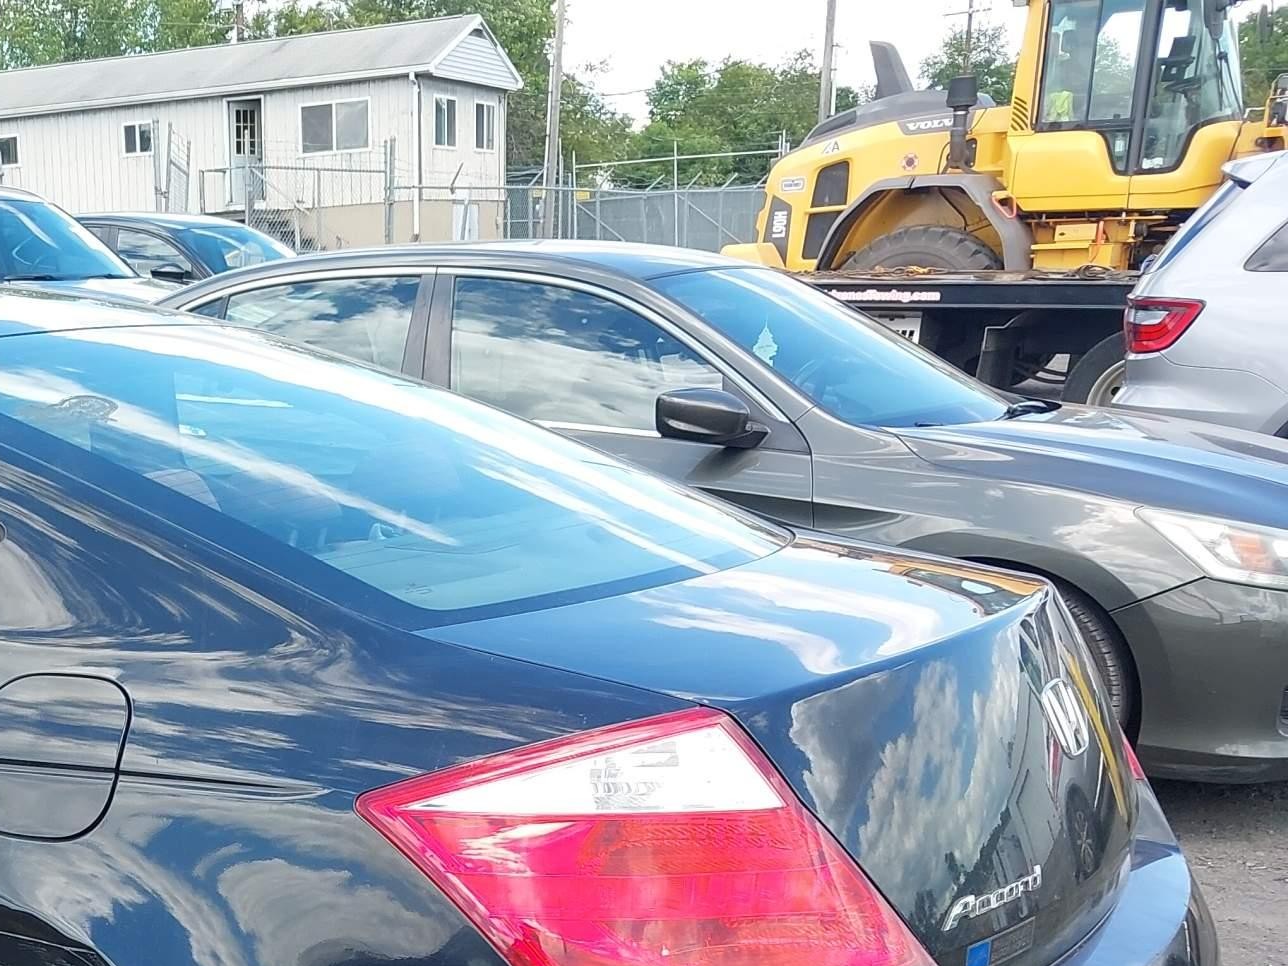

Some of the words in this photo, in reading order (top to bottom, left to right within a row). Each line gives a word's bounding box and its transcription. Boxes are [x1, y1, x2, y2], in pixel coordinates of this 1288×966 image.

[905, 119, 954, 131] VOLV
[772, 210, 788, 238] L90H
[941, 864, 1042, 932] Accord
